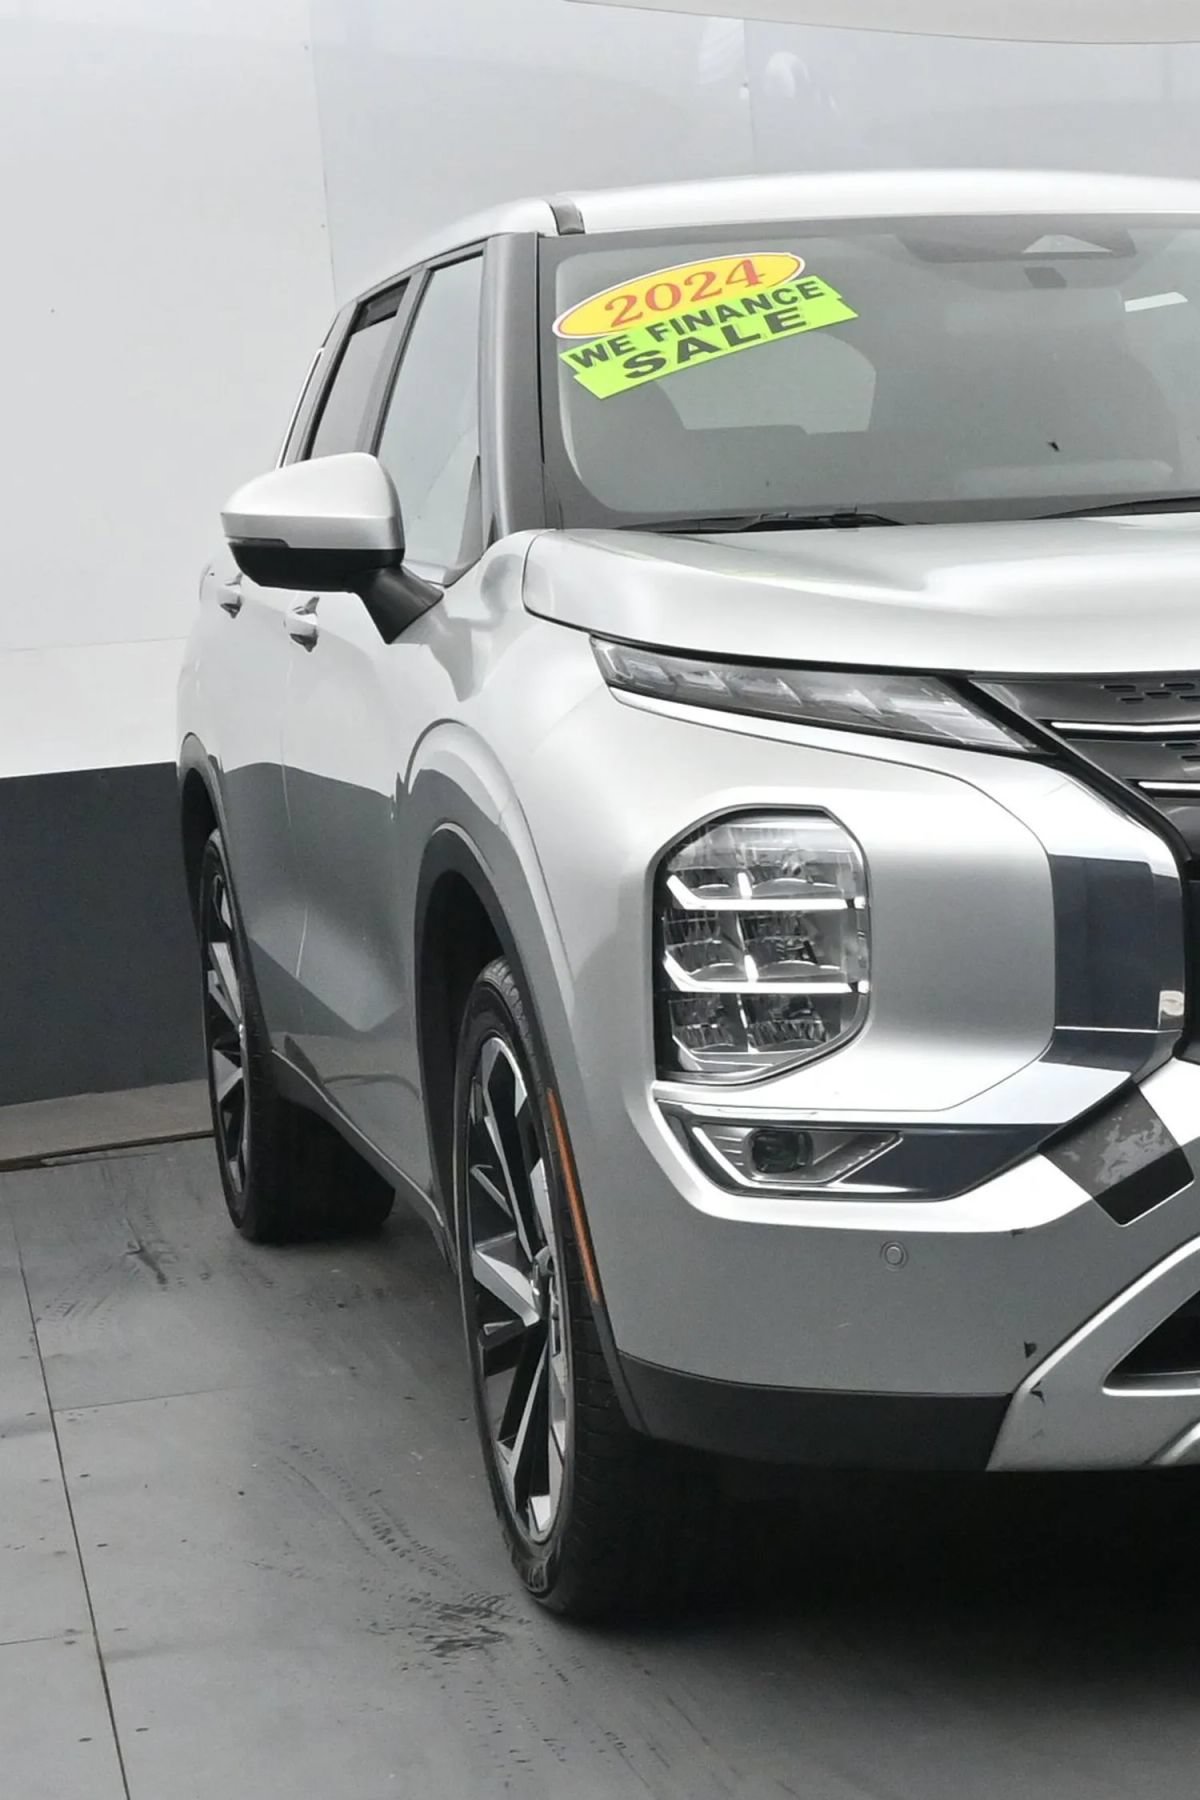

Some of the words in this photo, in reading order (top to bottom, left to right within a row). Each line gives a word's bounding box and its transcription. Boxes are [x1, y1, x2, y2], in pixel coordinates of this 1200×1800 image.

[569, 335, 637, 368] WE
[645, 280, 825, 342] FINANCE
[604, 259, 765, 328] 2024
[622, 307, 809, 379] SALE
